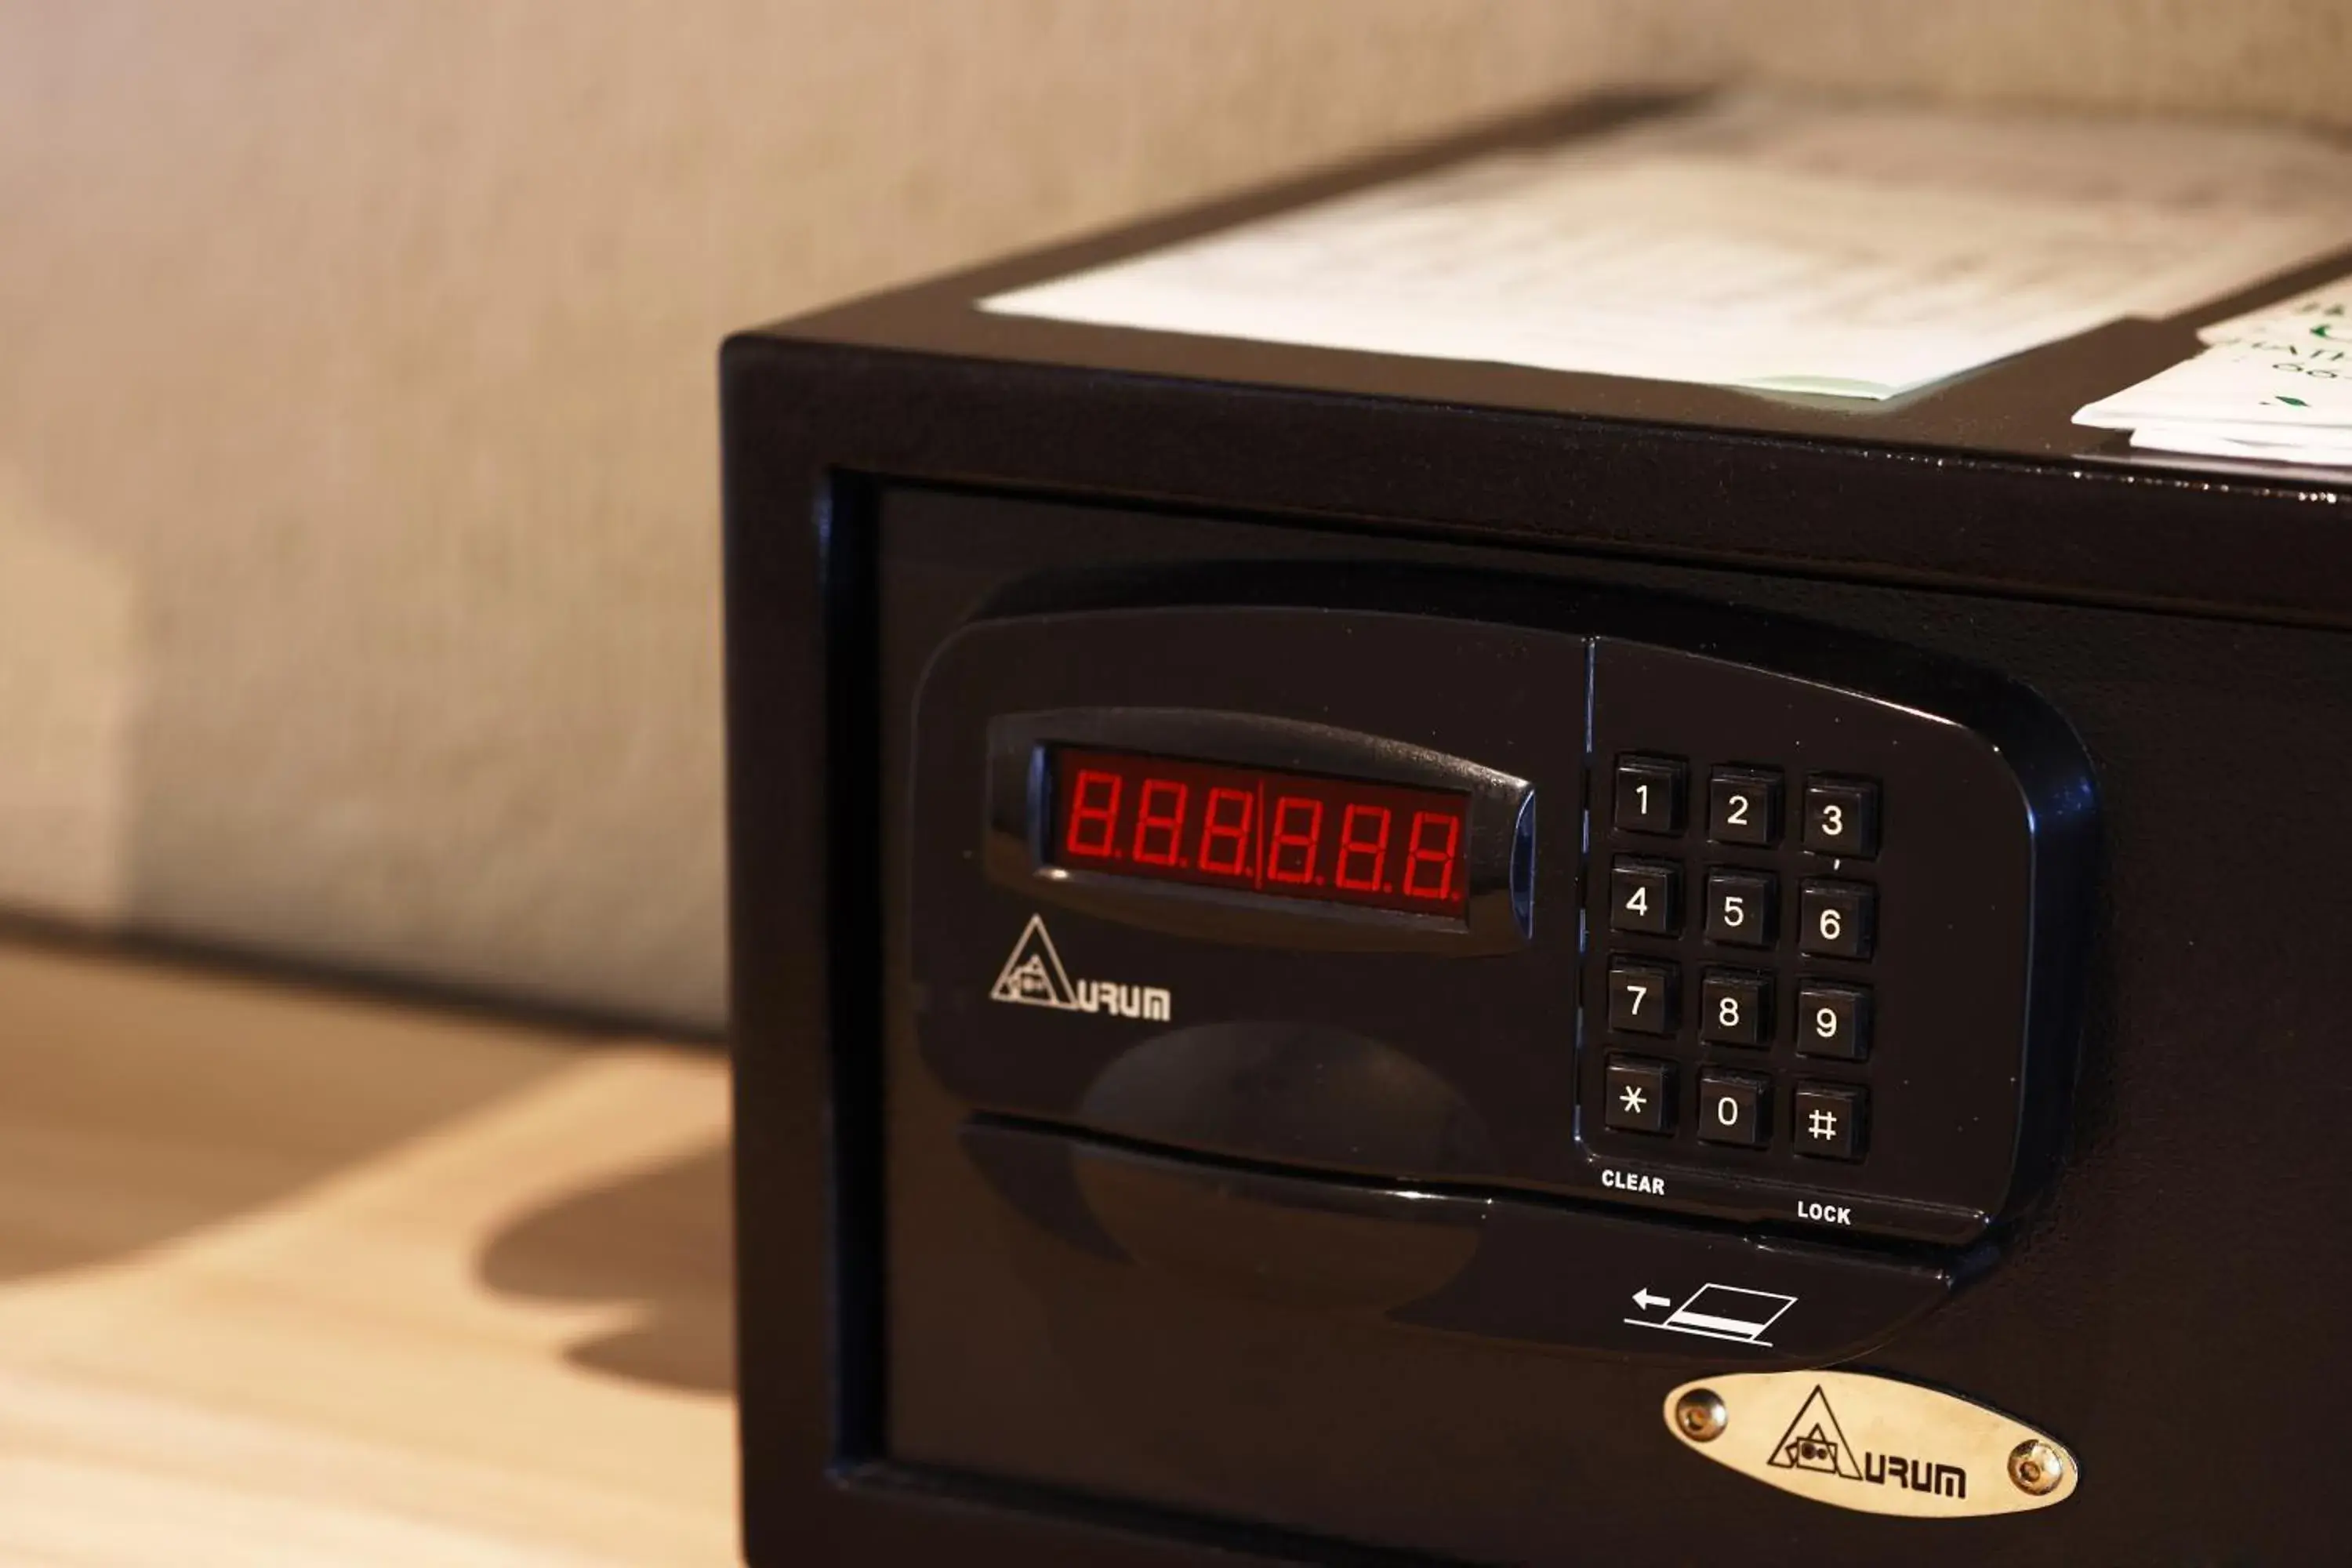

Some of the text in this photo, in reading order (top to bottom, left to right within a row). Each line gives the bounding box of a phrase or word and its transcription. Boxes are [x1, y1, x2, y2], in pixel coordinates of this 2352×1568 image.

[1635, 785, 1648, 815] 1
[1726, 795, 1749, 826] 2
[1820, 804, 1843, 837] 3
[1625, 887, 1649, 917] 4
[1723, 896, 1745, 927] 5
[1819, 909, 1842, 941] 6
[1626, 985, 1647, 1016] 7
[1718, 996, 1740, 1027] 8
[1816, 1007, 1838, 1039] 9
[1717, 1096, 1739, 1127] 0
[1601, 1168, 1666, 1196] CLEAR
[1797, 1200, 1852, 1226] LOCK
